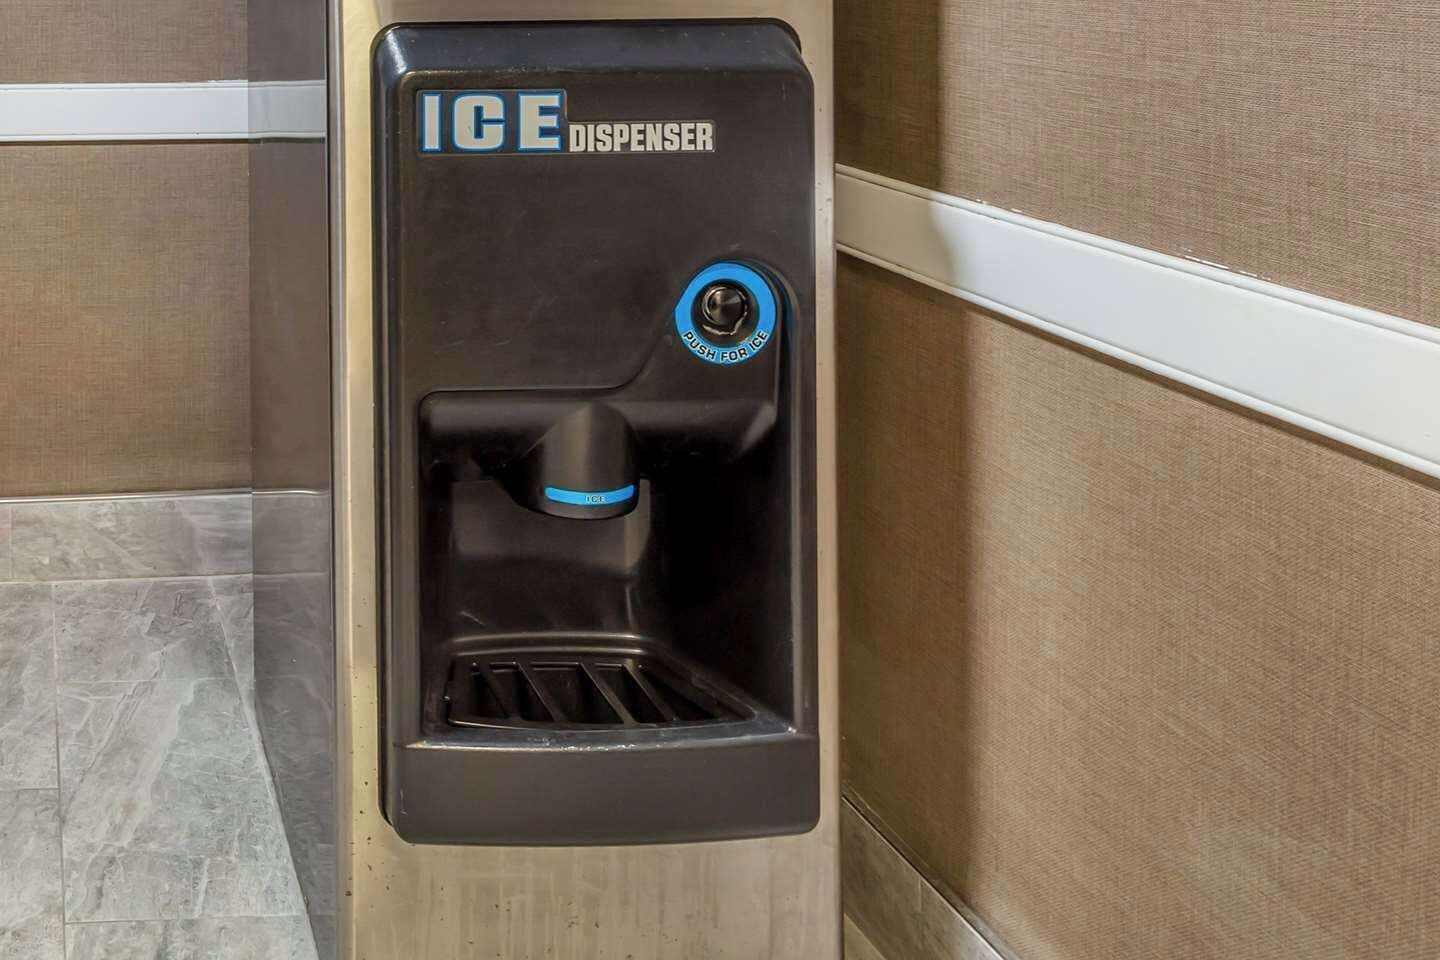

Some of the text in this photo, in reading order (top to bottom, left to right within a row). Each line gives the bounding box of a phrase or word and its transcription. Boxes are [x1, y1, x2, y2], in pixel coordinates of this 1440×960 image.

[421, 92, 714, 153] ICE DISPENSER
[683, 330, 768, 361] PUSH FOR ICE
[585, 496, 606, 504] ICE
